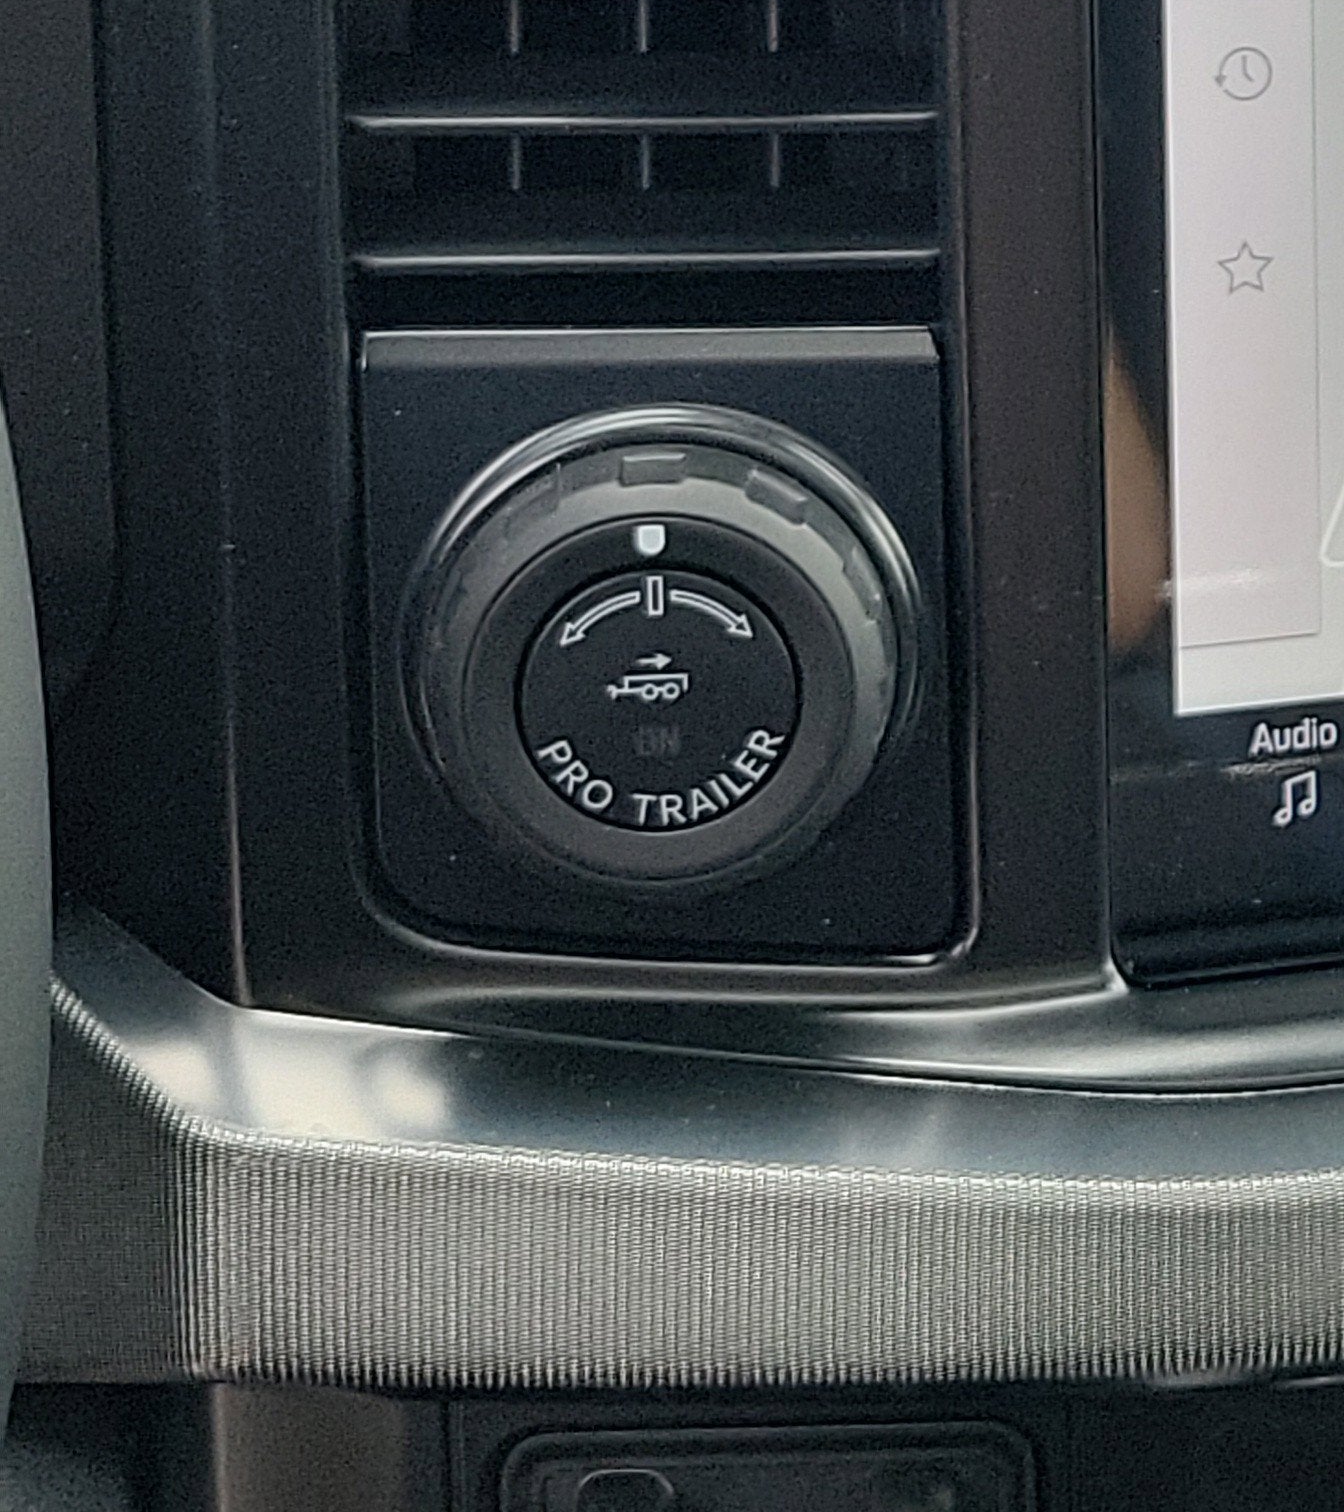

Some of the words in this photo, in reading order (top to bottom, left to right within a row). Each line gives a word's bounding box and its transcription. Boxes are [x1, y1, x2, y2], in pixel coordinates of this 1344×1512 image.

[1249, 716, 1337, 755] Audio
[538, 739, 614, 811] PRO
[632, 728, 786, 826] TRAILER
